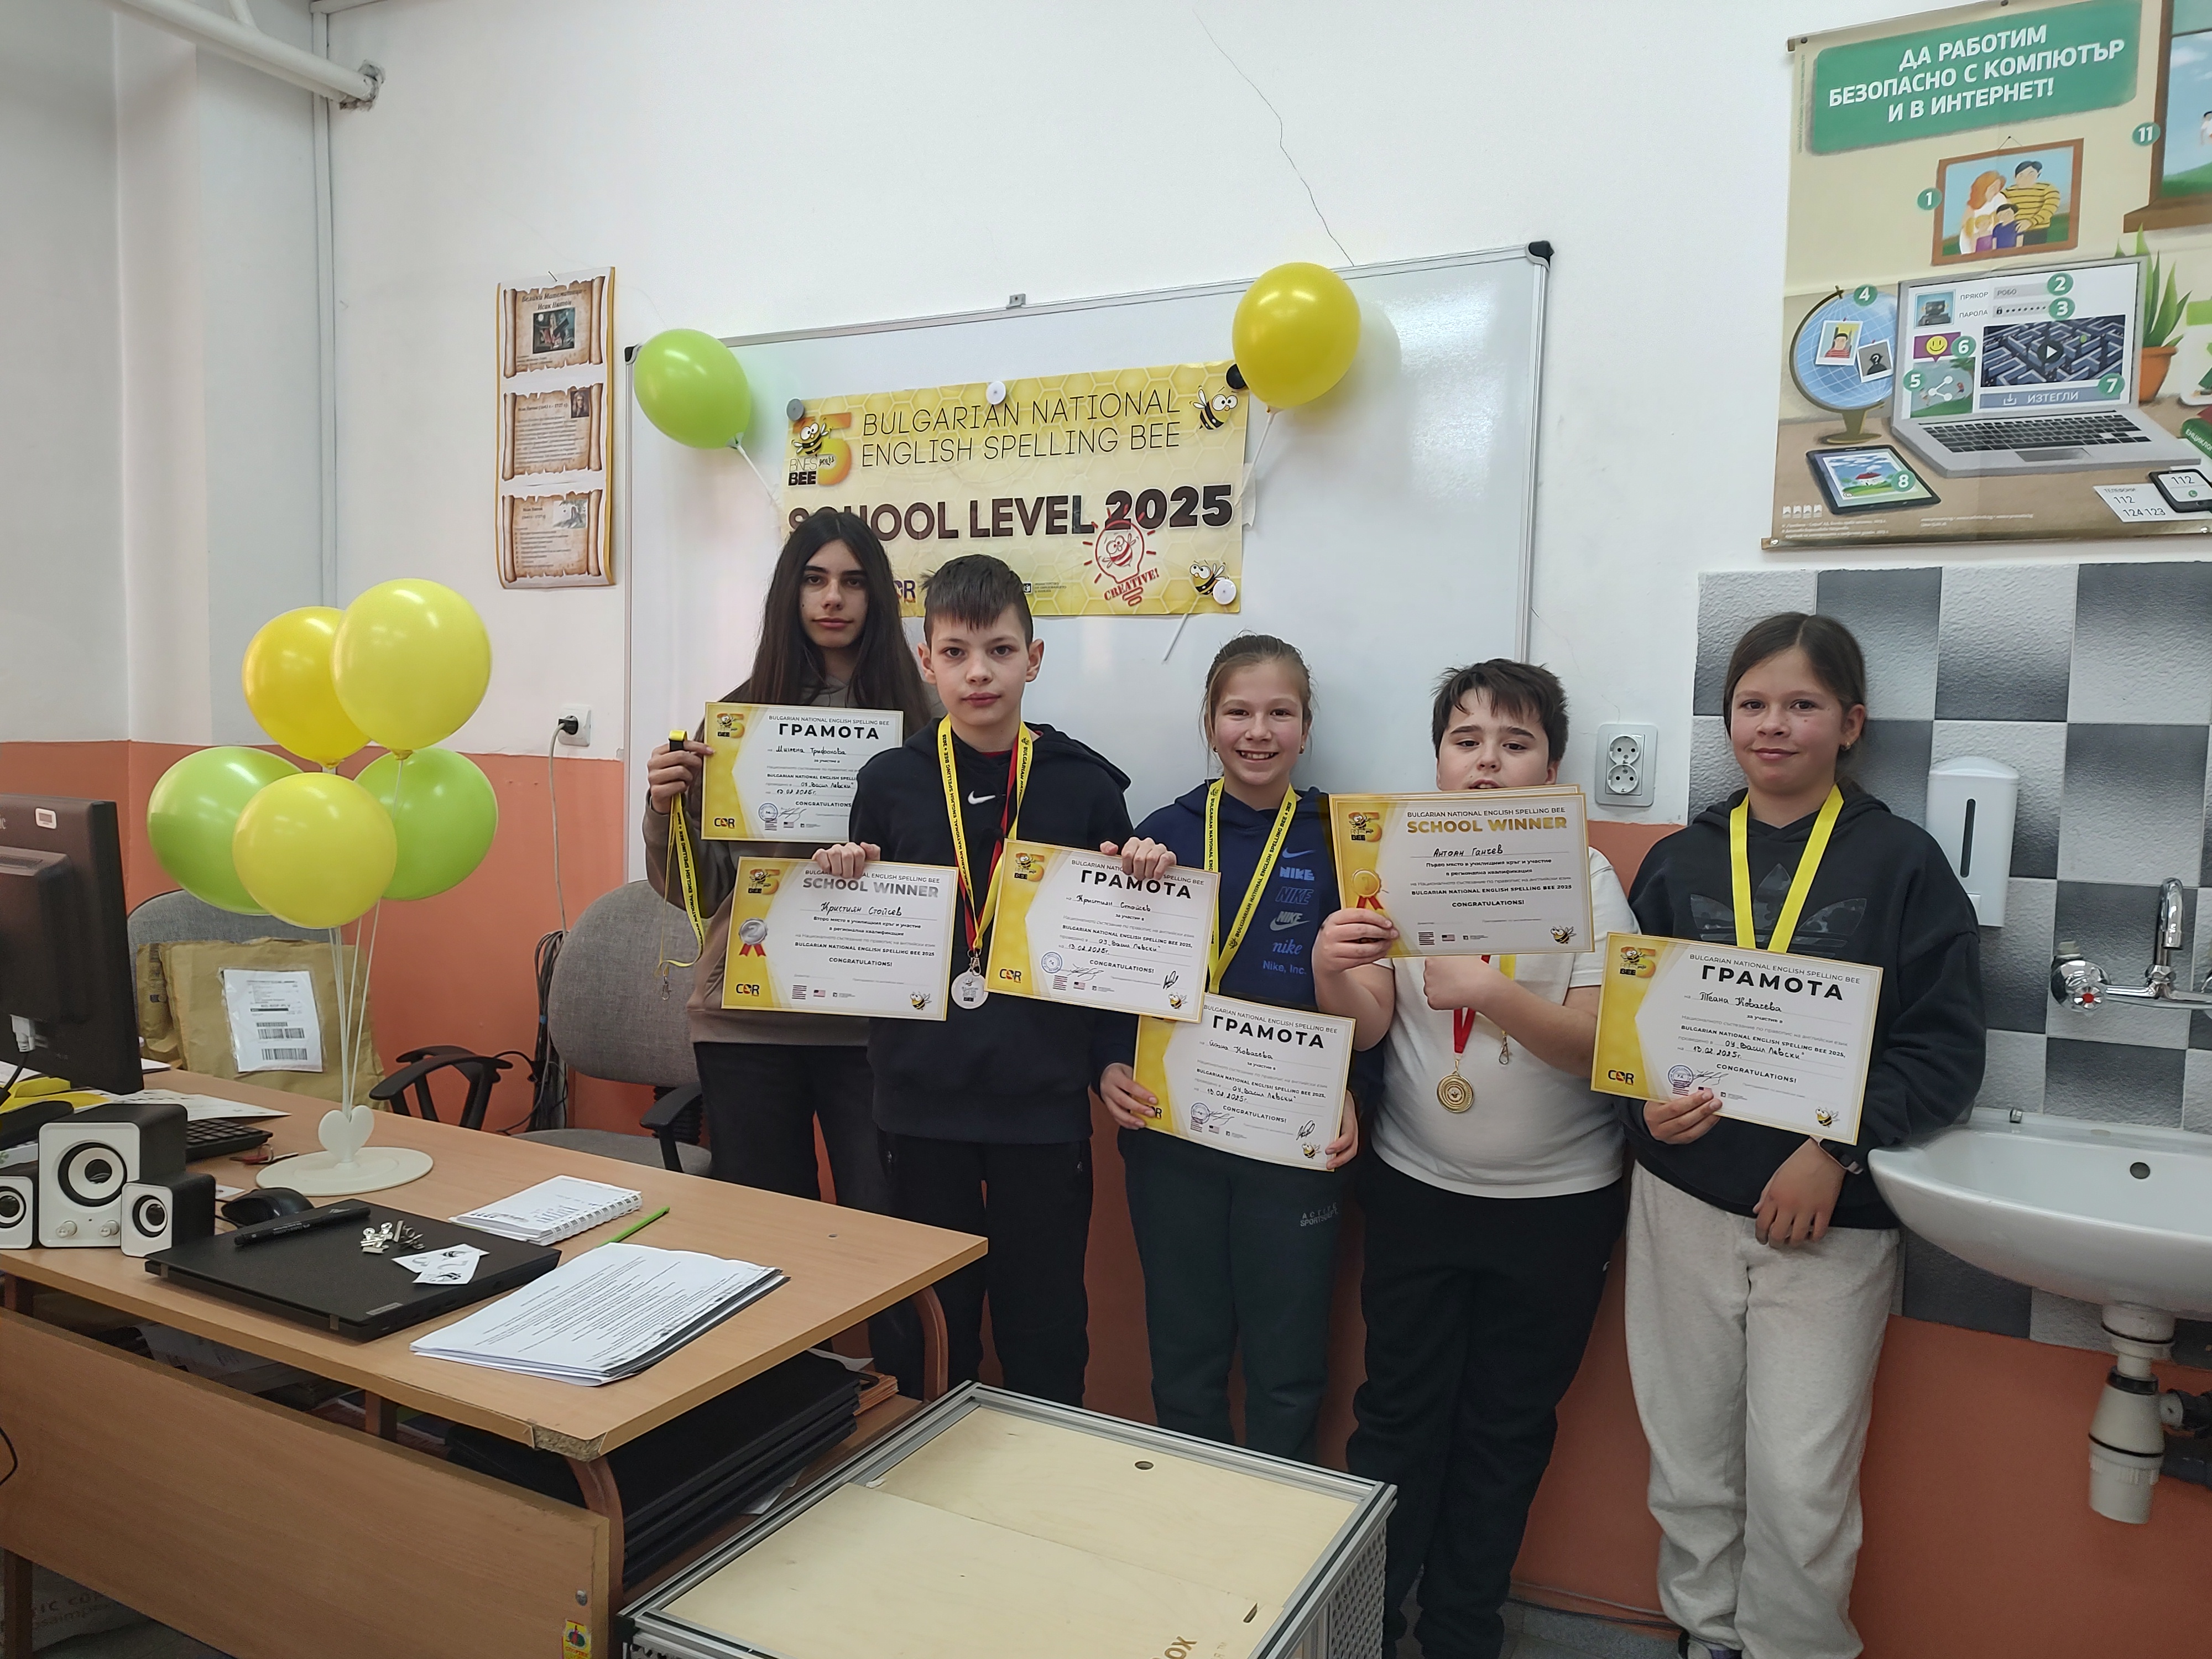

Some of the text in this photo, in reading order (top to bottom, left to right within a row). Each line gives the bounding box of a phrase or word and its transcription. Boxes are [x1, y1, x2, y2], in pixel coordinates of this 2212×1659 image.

[1898, 24, 2046, 72] ДА РАБОТИМ
[1829, 63, 1955, 107] БЕЗОПАСНО
[1964, 62, 1978, 83] С
[1985, 39, 2125, 80] КОМПЮТЪР
[1888, 77, 2054, 122] И В ИНТЕРНЕТ!
[2139, 127, 2153, 142] 11
[1926, 192, 1932, 205] 1
[2056, 278, 2067, 290] 2
[1859, 288, 1870, 301] 4
[1960, 287, 2017, 301] ПРЯКОР РОБО
[1959, 309, 1988, 319] ПАРОЛА
[2057, 303, 2068, 315] 3
[1958, 340, 1969, 353] 6
[1910, 374, 1921, 388] 5
[2106, 377, 2119, 393] 7
[2027, 391, 2078, 404] ИЗТЕГЛИ
[863, 388, 1181, 436] BULGARIAN NATIONAL
[862, 421, 1181, 467] ENGLISH SPELLING BEE
[788, 471, 816, 486] BEE
[1898, 474, 1911, 488] 8
[2172, 476, 2195, 484] 112
[969, 494, 1095, 539] LEVEL
[1104, 484, 1233, 531] 2025
[1104, 568, 1160, 601] CREATIVE!
[779, 723, 879, 739] ГРАМОТА
[1407, 816, 1567, 833] SCHOOL WINNER
[1072, 859, 1105, 869] BULGARIAN
[1163, 874, 1191, 883] SPELLING
[1279, 866, 1315, 882] NIKE
[803, 878, 938, 898] SCHOOL WINNER
[1081, 870, 1191, 899] ГРАМОТА
[1234, 902, 1253, 937] BULGARIAN
[1260, 853, 1272, 878] ENGLISH
[1270, 828, 1283, 853] SPELLING
[1275, 886, 1314, 905] NIKE
[1277, 911, 1303, 924] NIKE
[1062, 925, 1092, 933] BULGARIAN
[1272, 938, 1303, 955] nike
[829, 957, 893, 967] CONGRATULATIONS!
[1089, 959, 1154, 974] CONGRATULATIONS!
[1263, 960, 1307, 975] Nike, Inc.
[1689, 954, 1731, 964] BULGARIAN
[1734, 959, 1771, 970] NATIONAL
[1772, 965, 1804, 975] ENGLISH
[1806, 970, 1843, 981] SPELLING
[1702, 964, 1843, 1001] ГРАМОТА
[1204, 1004, 1236, 1016] BULGARIAN
[1238, 1012, 1266, 1022] NATIONAL
[1268, 1018, 1294, 1027] ENGLISH
[1295, 1022, 1324, 1032] SPELLING
[1213, 1015, 1324, 1049] ГРАМОТА
[1681, 1025, 1717, 1035] BULGARIAN
[1719, 1031, 1751, 1040] NATIONAL
[1752, 1036, 1780, 1045] ENGLISH
[1782, 1041, 1813, 1051] SPELLING
[1197, 1068, 1224, 1078] BULGARIAN
[1225, 1074, 1250, 1085] NATIONAL
[1275, 1086, 1300, 1094] SPELLING
[1716, 1063, 1796, 1083] CONGRATULATIONS!
[1223, 1105, 1286, 1123] CONGRATULATIONS!
